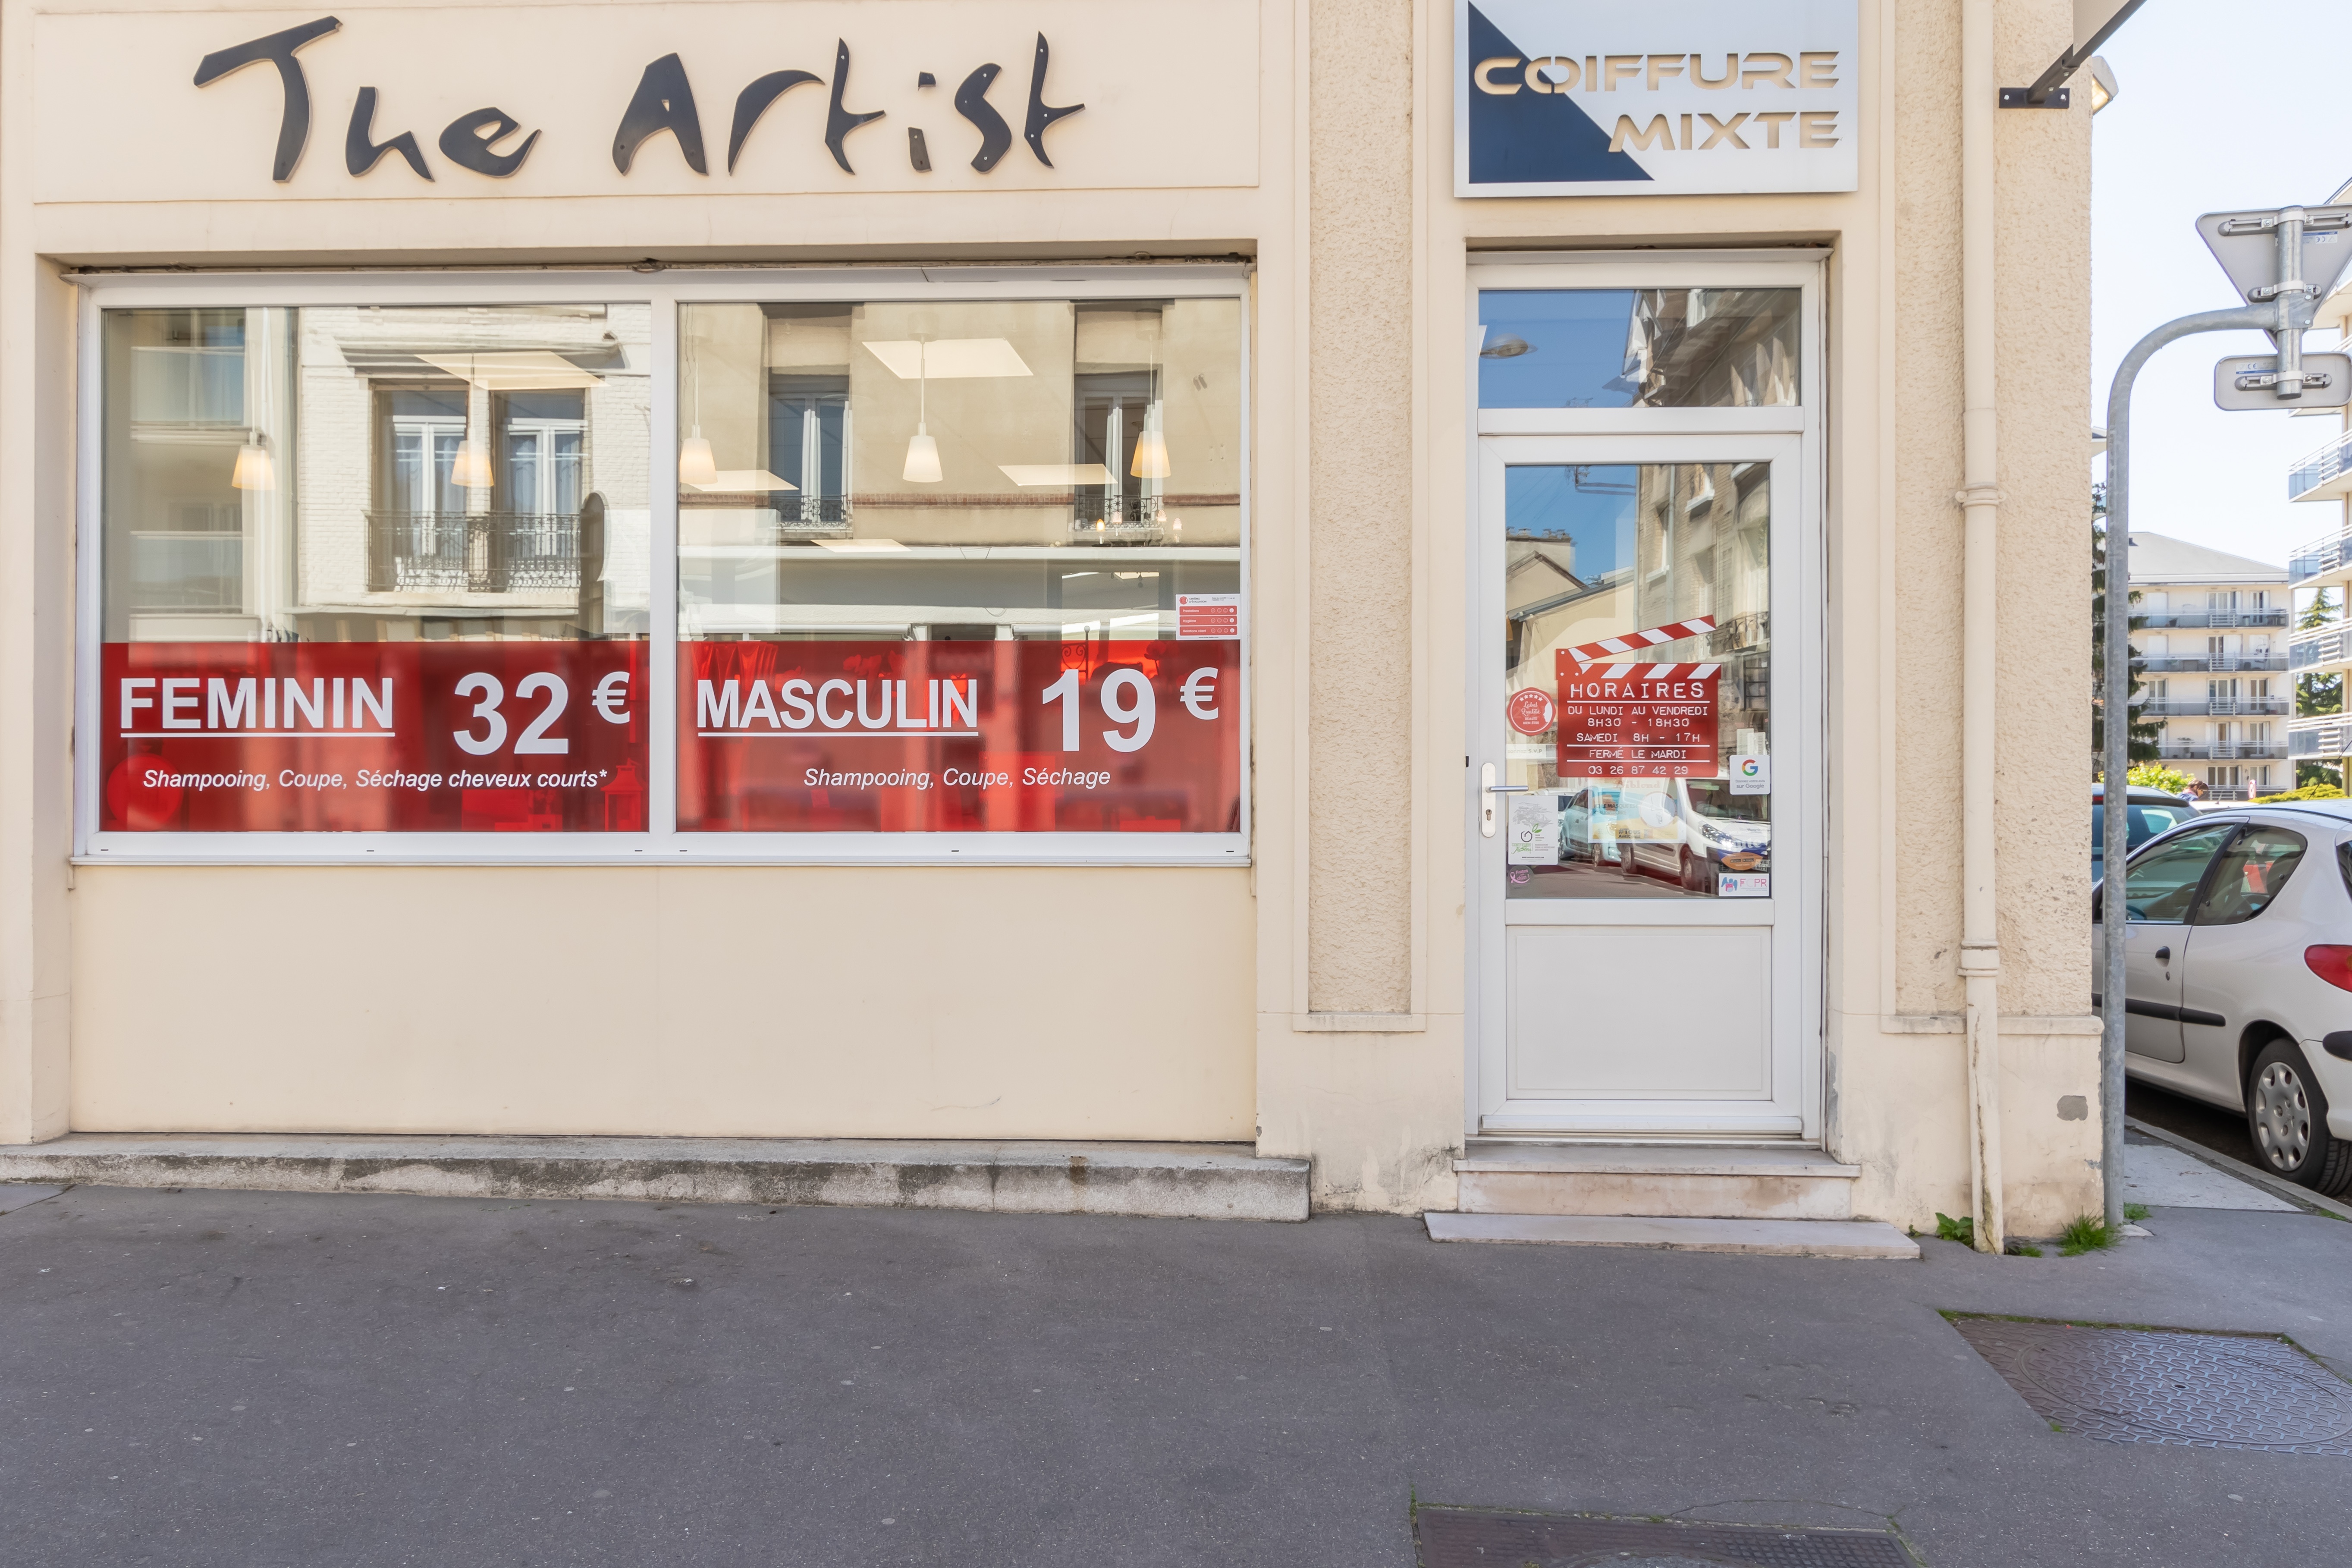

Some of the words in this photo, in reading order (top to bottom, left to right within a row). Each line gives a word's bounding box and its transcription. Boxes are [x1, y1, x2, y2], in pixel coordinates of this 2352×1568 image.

[1474, 51, 1840, 95] COIFFURE
[194, 16, 542, 183] The
[612, 31, 1085, 176] Artist
[1608, 111, 1840, 152] MIXTE
[1570, 682, 1704, 698] HORAIRES
[121, 678, 393, 729] FEMININ
[697, 679, 977, 729] MASCULIN
[1042, 668, 1156, 752] 19
[1180, 667, 1218, 720] €
[1521, 708, 1541, 716] Qualité
[1523, 701, 1538, 709] Label
[1567, 706, 1582, 715] DU
[1589, 706, 1623, 715] LUNDI
[1631, 706, 1645, 715] AU
[1652, 706, 1708, 716] VENDREDI
[453, 672, 569, 756] 32
[592, 671, 630, 724] €
[1587, 718, 1622, 727] 8H30
[1648, 718, 1690, 727] 18H30
[1576, 733, 1618, 742] SAMEDI
[1633, 733, 1649, 742] 8H
[1676, 732, 1700, 742] 17H
[1589, 746, 1624, 759] FERMÉ
[1631, 750, 1645, 759] LE
[1651, 750, 1686, 759] MARDI
[804, 768, 934, 790] Shampooing,
[943, 768, 1014, 789] Coupe,
[1022, 767, 1111, 789] Séchage
[1588, 766, 1602, 775] 03
[1610, 766, 1623, 775] 26
[1631, 766, 1645, 775] 87
[1652, 766, 1666, 775] 42
[1674, 766, 1688, 775] 29
[144, 770, 270, 792] Shampooing,
[279, 770, 347, 791] Coupe,
[356, 770, 443, 792] Séchage
[449, 770, 531, 787] cheveux
[1740, 878, 1767, 887] FCPR
